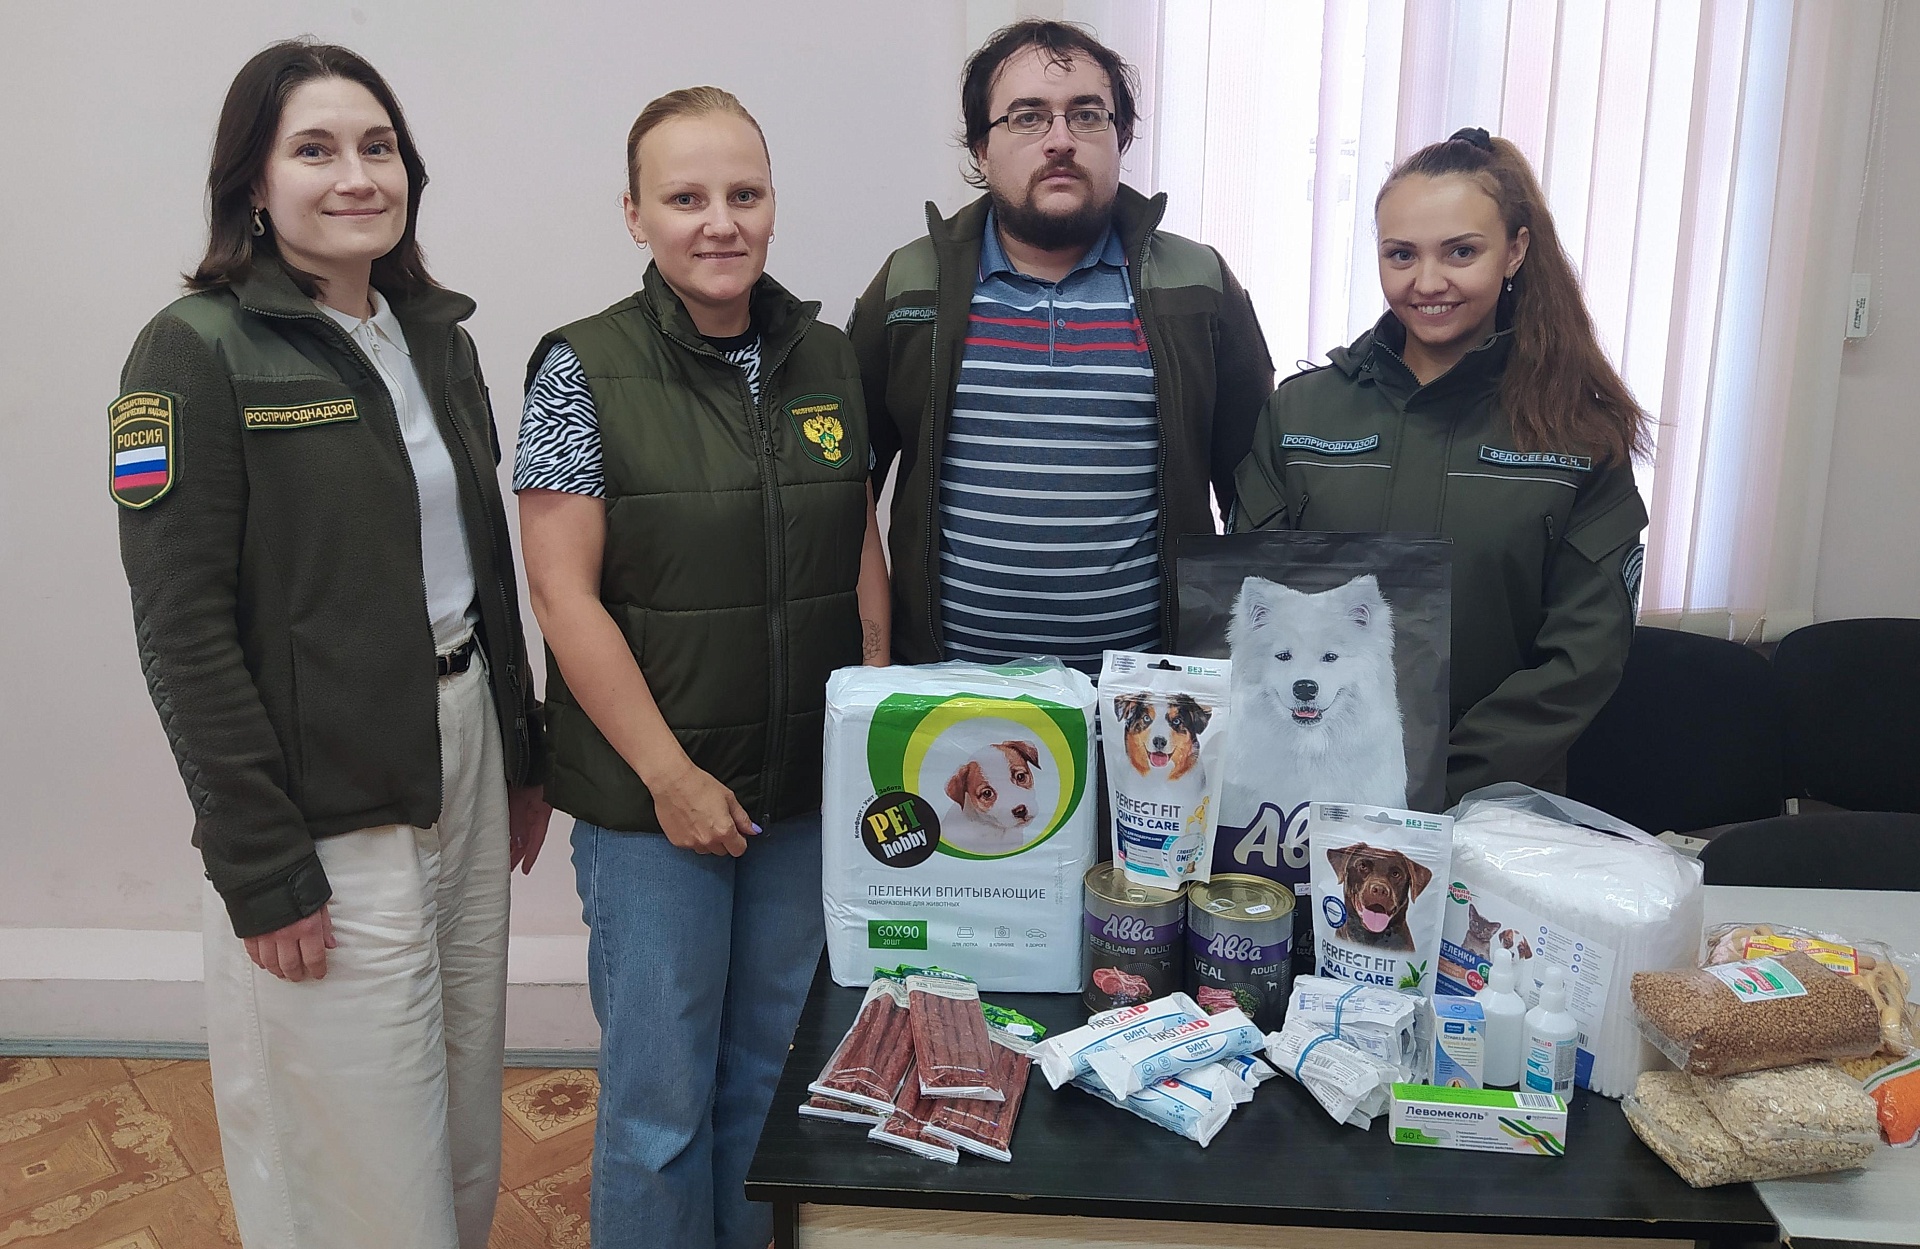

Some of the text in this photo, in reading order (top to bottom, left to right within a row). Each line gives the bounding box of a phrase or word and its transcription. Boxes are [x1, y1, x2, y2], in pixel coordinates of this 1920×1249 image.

[147, 407, 169, 419] НАДЗОР
[247, 403, 352, 423] РОСПРИРОДНАДЗОР
[117, 428, 164, 449] РОССИЯ
[1285, 436, 1376, 451] РОСПРИРОДНАДЗОР
[1490, 449, 1581, 467] ФЕДОСЕЕВА С.Н.
[1115, 790, 1181, 818] PERFECT FIT
[867, 799, 921, 843] PET
[1147, 818, 1180, 832] CARE
[1406, 819, 1422, 827] БЕЗ
[881, 829, 928, 859] hobby
[868, 885, 1046, 900] ПЕЛЕНКИ ВПИТЫВАЮЩИЕ
[1143, 944, 1171, 955] ADULT
[1321, 938, 1371, 968] PERFECT
[1374, 957, 1396, 973] FIT
[1194, 957, 1226, 981] VEAL
[1250, 964, 1279, 976] ADULT
[1323, 954, 1394, 987] ORAL CARE
[1122, 1025, 1149, 1042] БИНТ
[1185, 1038, 1212, 1054] БИНТ
[1405, 1106, 1484, 1120] Левомеколь
[1402, 1131, 1415, 1140] 40
